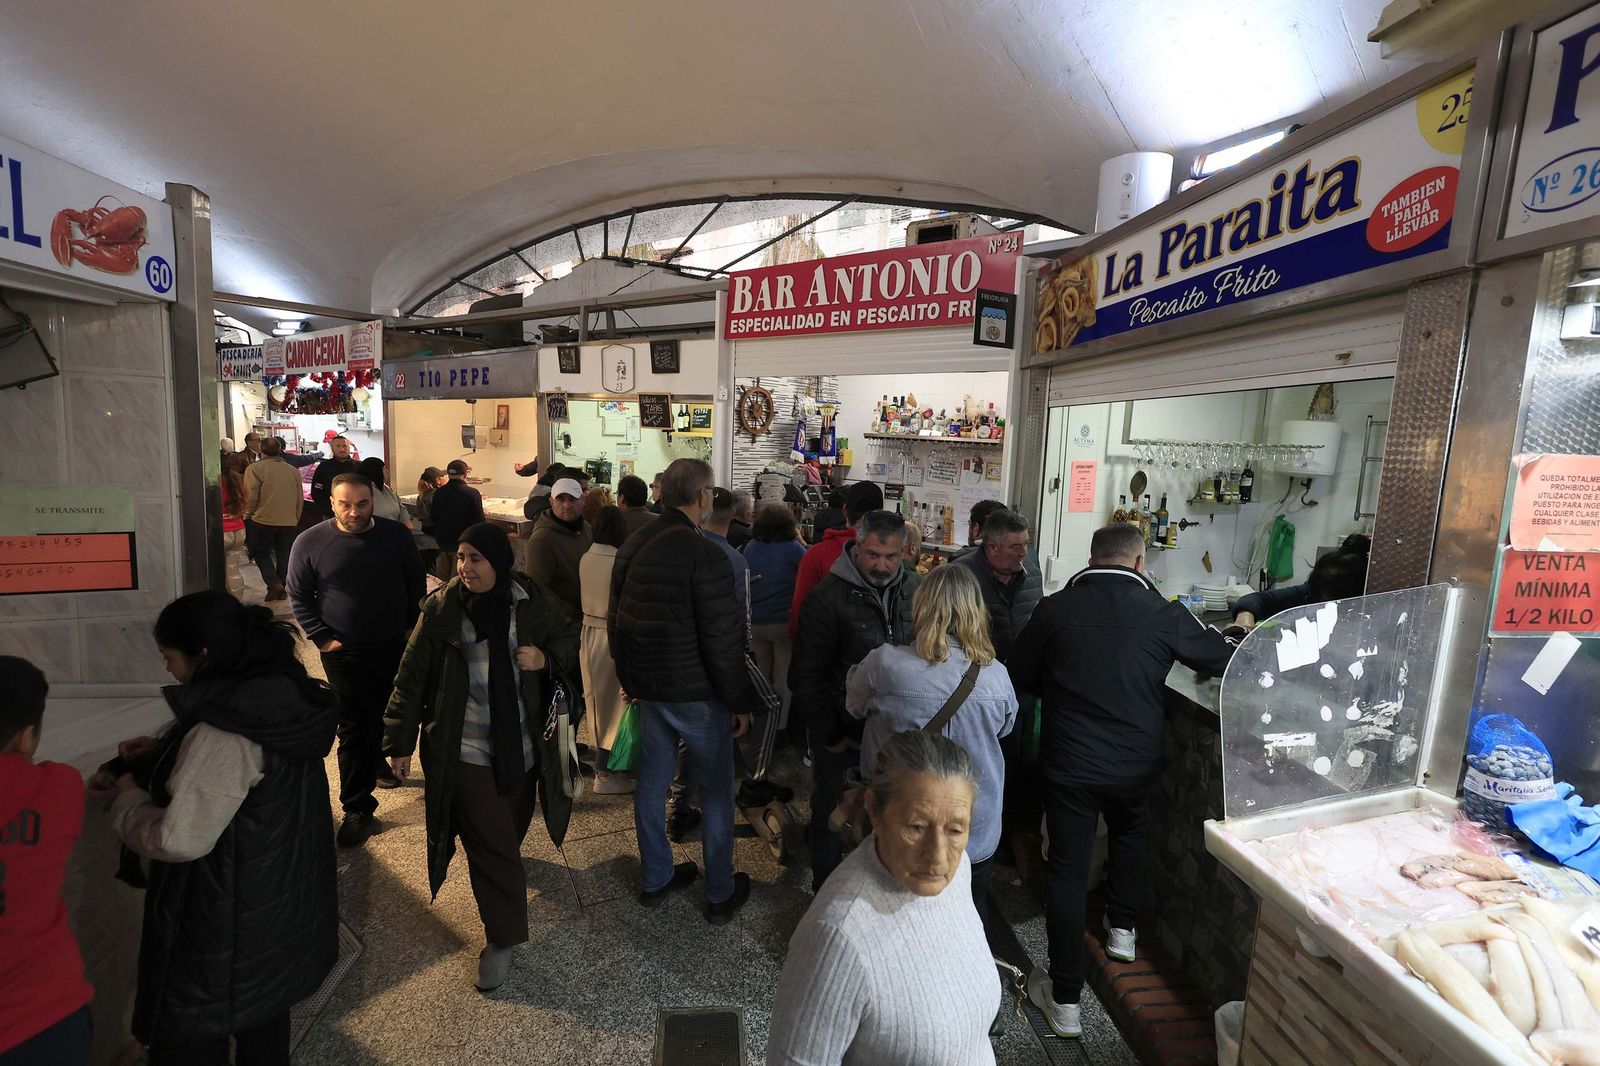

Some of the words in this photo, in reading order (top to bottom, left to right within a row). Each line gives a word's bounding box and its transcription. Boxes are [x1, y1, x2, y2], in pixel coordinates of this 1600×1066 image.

[1381, 175, 1446, 217] TAMBIEN
[1394, 198, 1431, 226] PARA
[1103, 249, 1143, 299] La
[1156, 156, 1362, 281] Paraita
[1386, 208, 1439, 243] LLEVAR
[1004, 236, 1019, 252] 24
[149, 260, 170, 288] 60
[731, 274, 796, 314] BAR
[804, 250, 982, 307] ANTONIO
[1128, 290, 1208, 327] Pescaito
[1213, 265, 1280, 298] Frito
[730, 312, 824, 334] ESPECIALIDAD
[830, 309, 850, 327] EN
[857, 302, 940, 325] PESCAITO
[222, 348, 262, 360] PESCADERIA
[286, 334, 346, 369] CARNICERIA
[395, 374, 405, 388] 22
[419, 370, 441, 388] TIO
[450, 366, 490, 387] PEPE
[1540, 474, 1565, 482] QUEDA
[1550, 483, 1590, 492] PROHIBIDO
[1533, 500, 1560, 508] PUESTO
[1562, 501, 1582, 509] PARA
[1538, 492, 1581, 500] UTILIZACION
[1534, 509, 1574, 517] CUALQUIER
[1523, 554, 1586, 571] VENTA
[1514, 577, 1592, 598] MÍNIMA
[1505, 608, 1542, 627] 1/2
[1548, 608, 1593, 625] KILO
